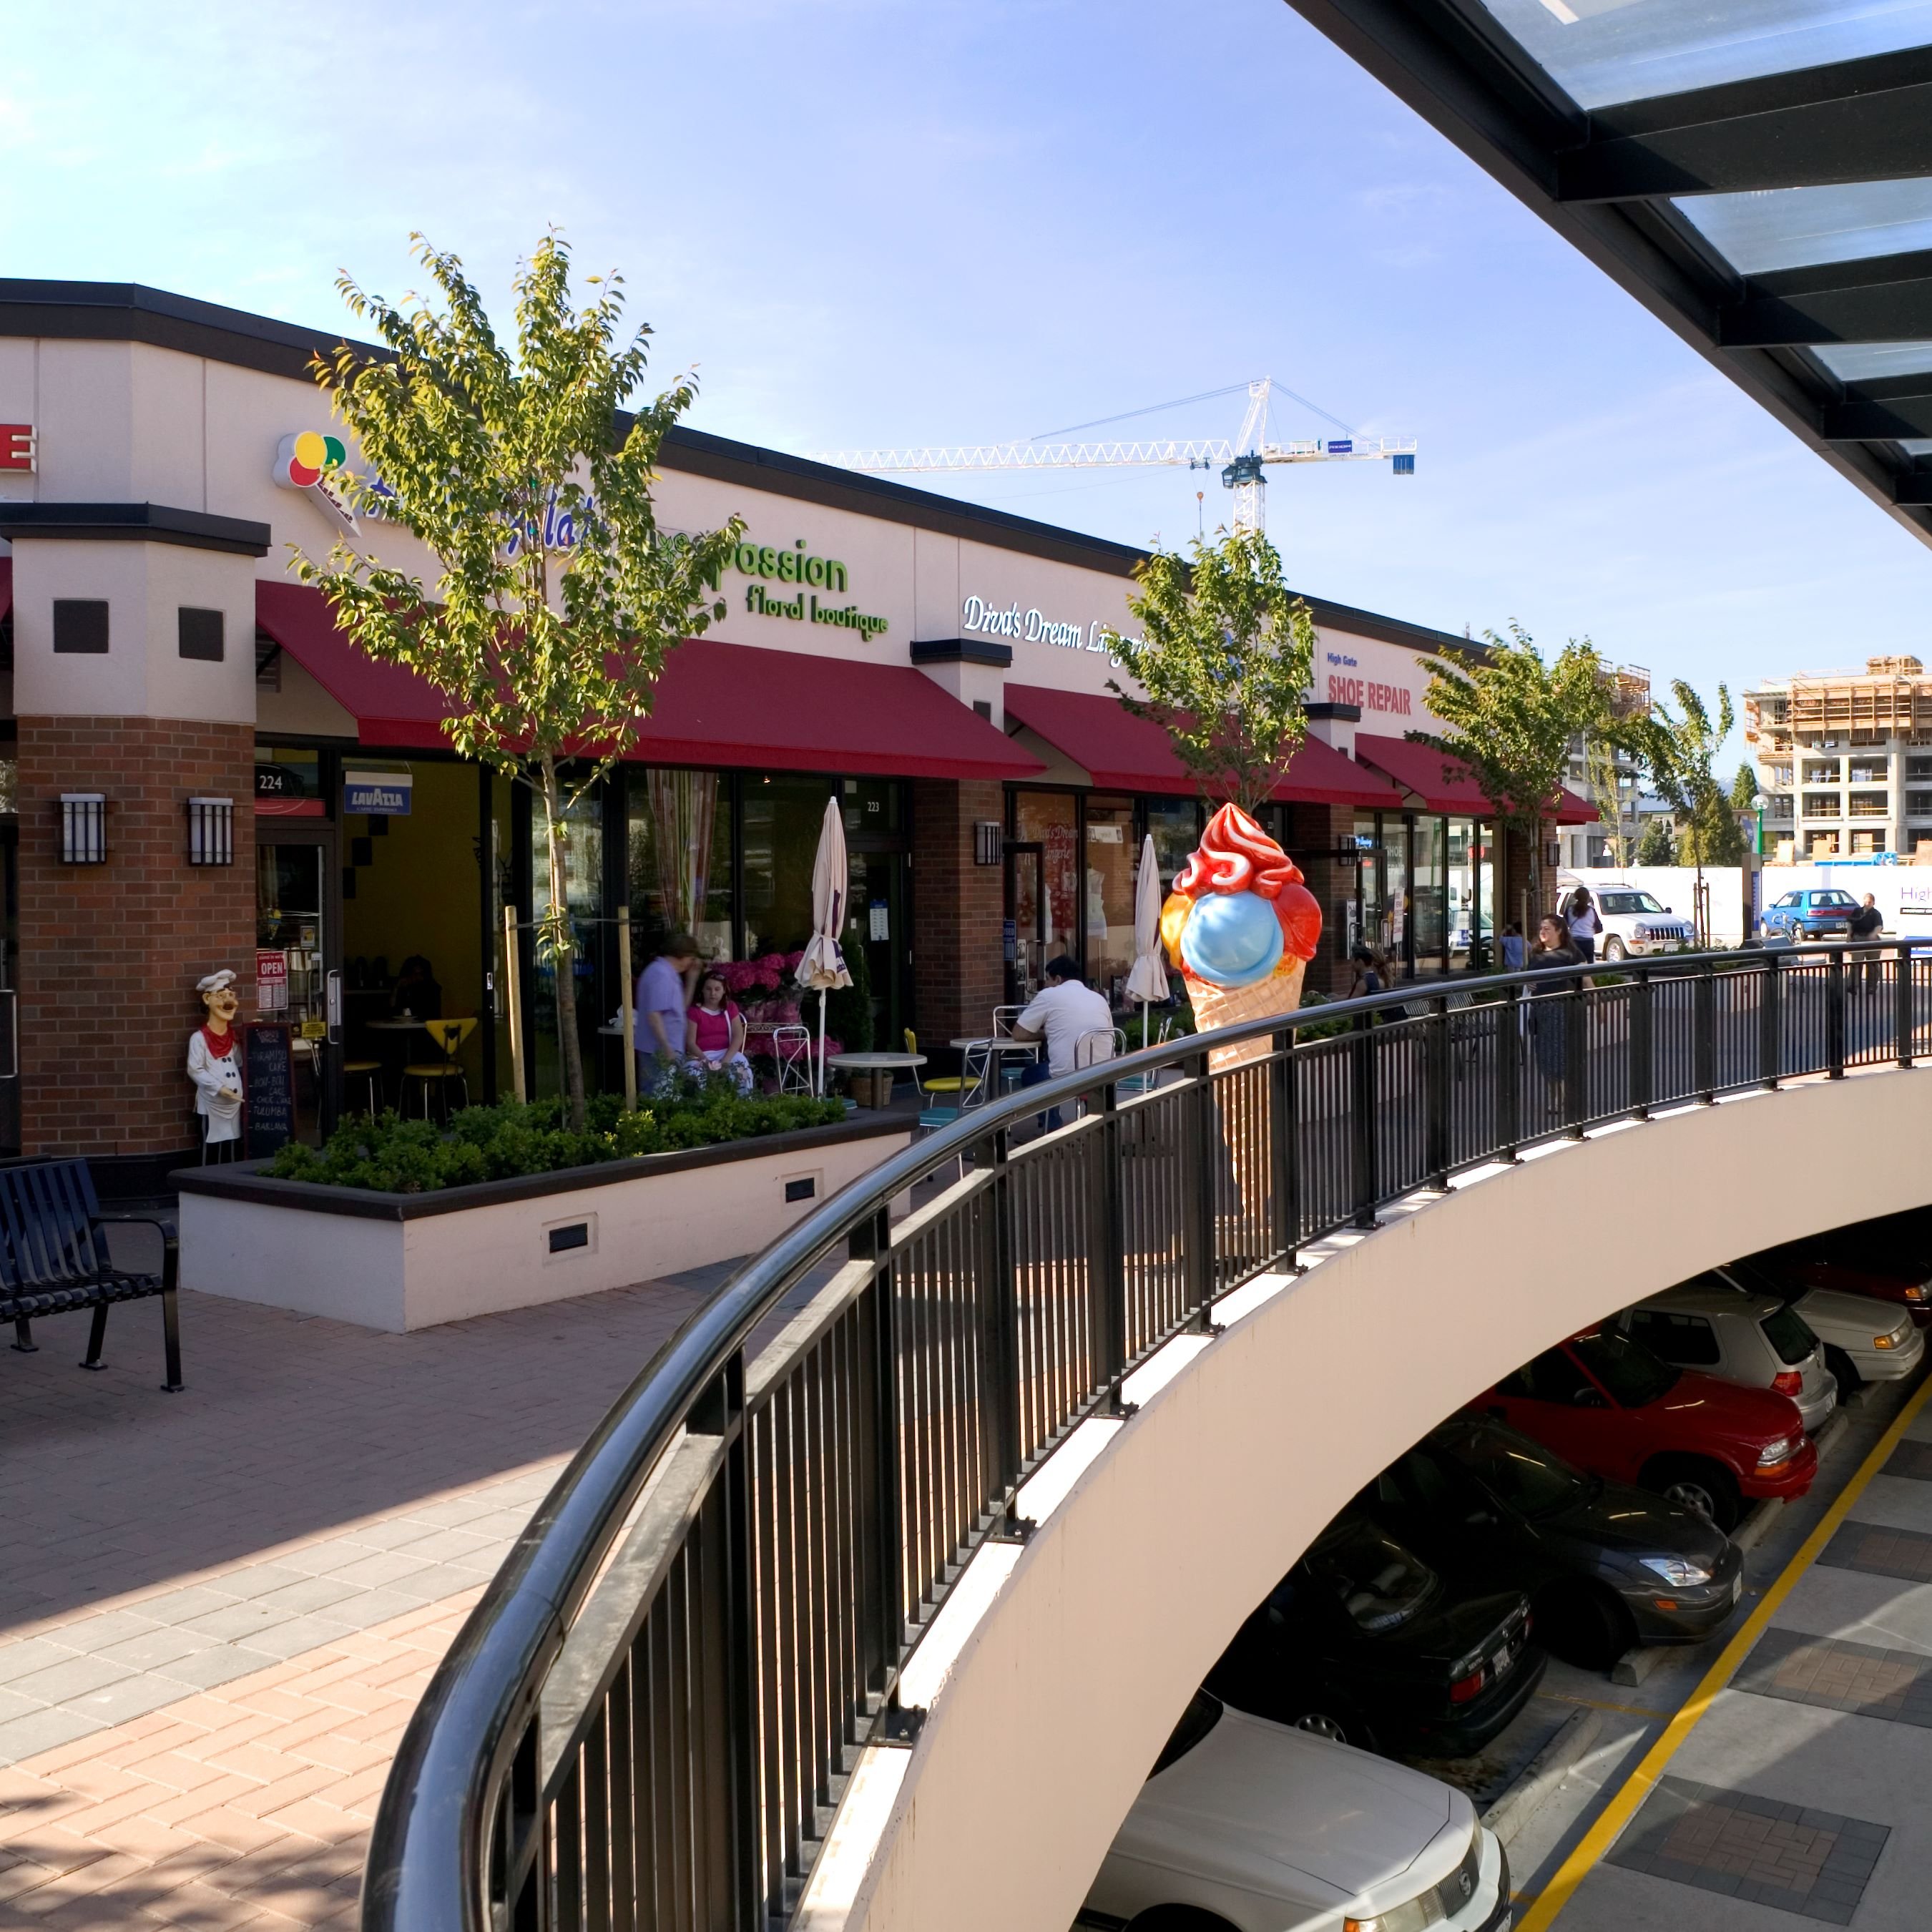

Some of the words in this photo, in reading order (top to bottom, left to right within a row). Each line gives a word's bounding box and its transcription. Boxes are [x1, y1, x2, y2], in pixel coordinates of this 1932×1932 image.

[712, 539, 848, 592] passion
[747, 584, 805, 621] floral
[811, 595, 889, 642] boutique
[963, 594, 1021, 639] Diva's
[1024, 608, 1083, 649] Dream
[1328, 652, 1341, 666] High
[1343, 655, 1358, 667] Gate
[1328, 675, 1364, 707] SHOE
[1367, 681, 1411, 715] REPAIR
[259, 775, 283, 789] 224
[351, 788, 403, 806] LAVAZZA
[868, 801, 880, 813] 223
[1044, 845, 1071, 864] ingerie
[1386, 845, 1403, 858] SHOE
[1387, 863, 1406, 876] EPAIR
[261, 962, 283, 975] OPEN
